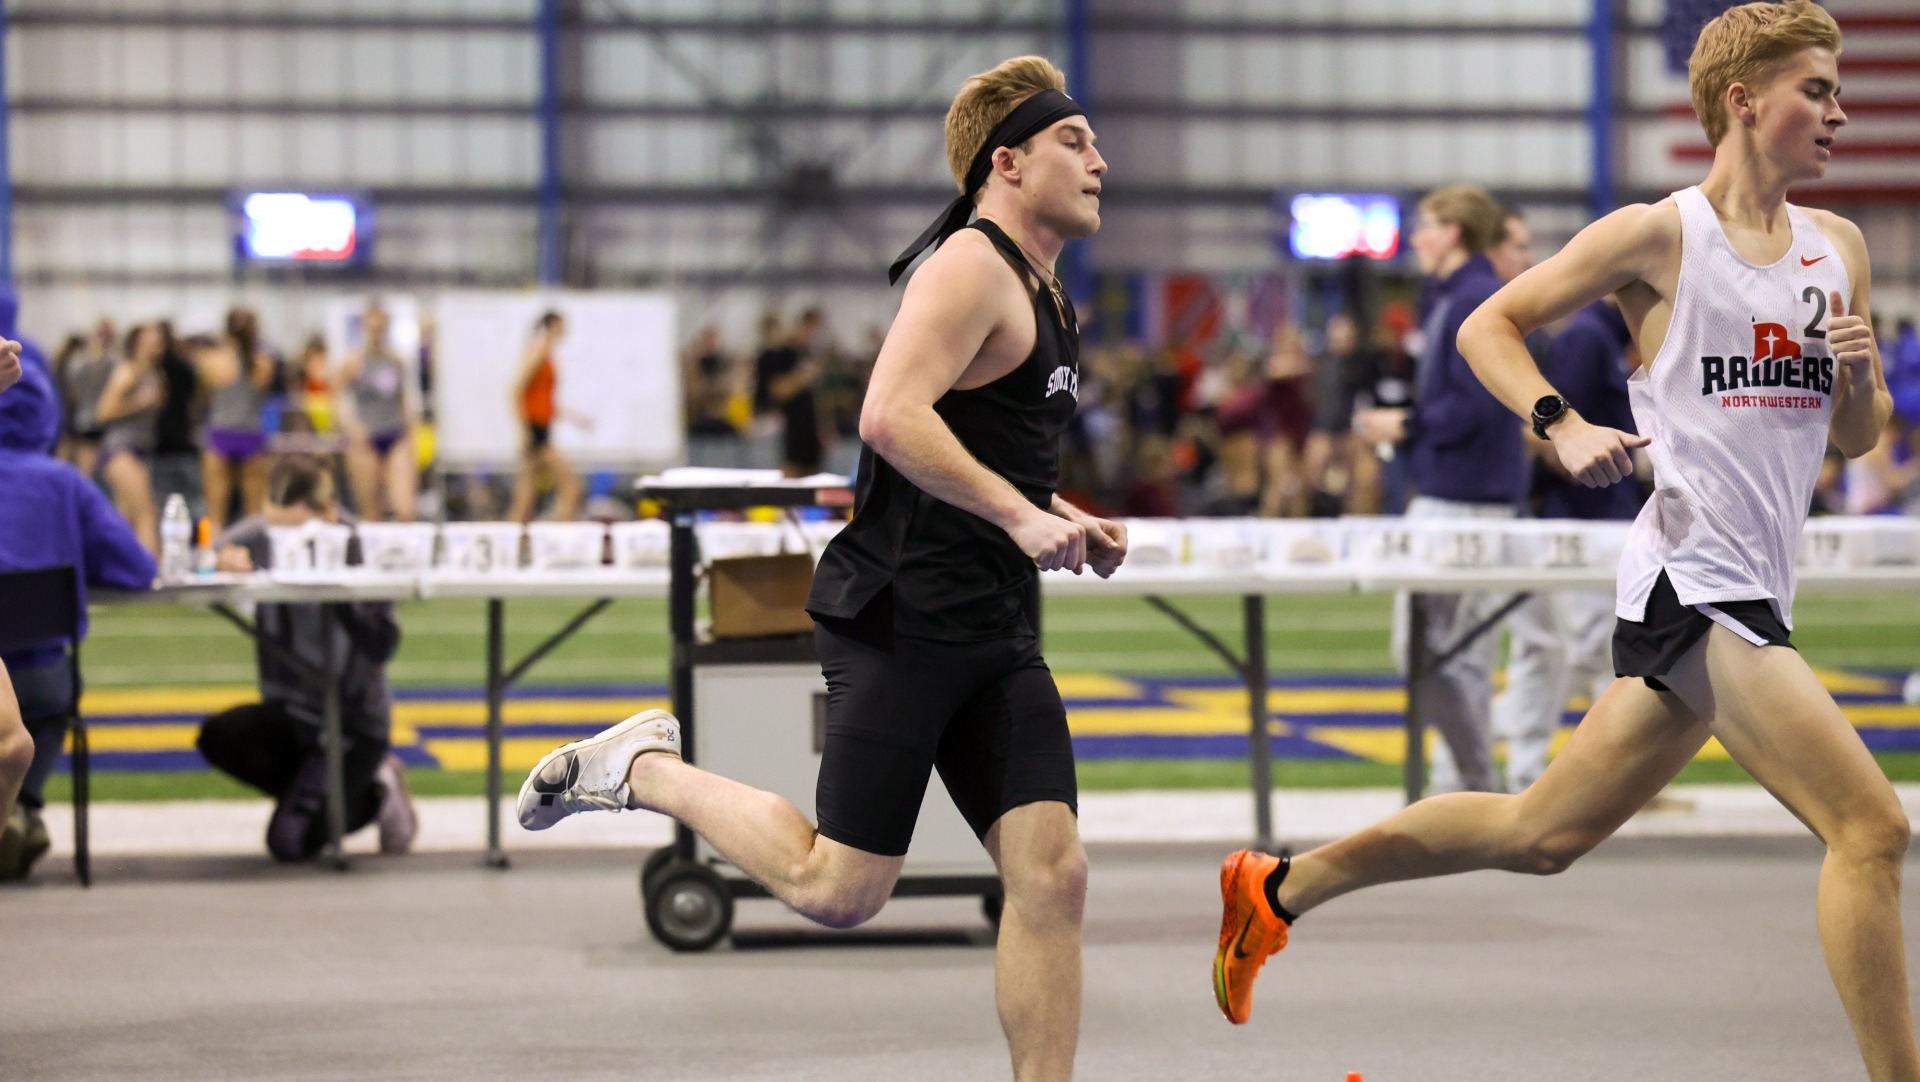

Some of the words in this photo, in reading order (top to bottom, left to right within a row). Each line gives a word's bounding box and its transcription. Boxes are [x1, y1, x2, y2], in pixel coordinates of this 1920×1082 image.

[1802, 285, 1827, 340] 2
[1700, 355, 1834, 397] RAIDERS
[1721, 395, 1822, 409] NORTHWESTERN
